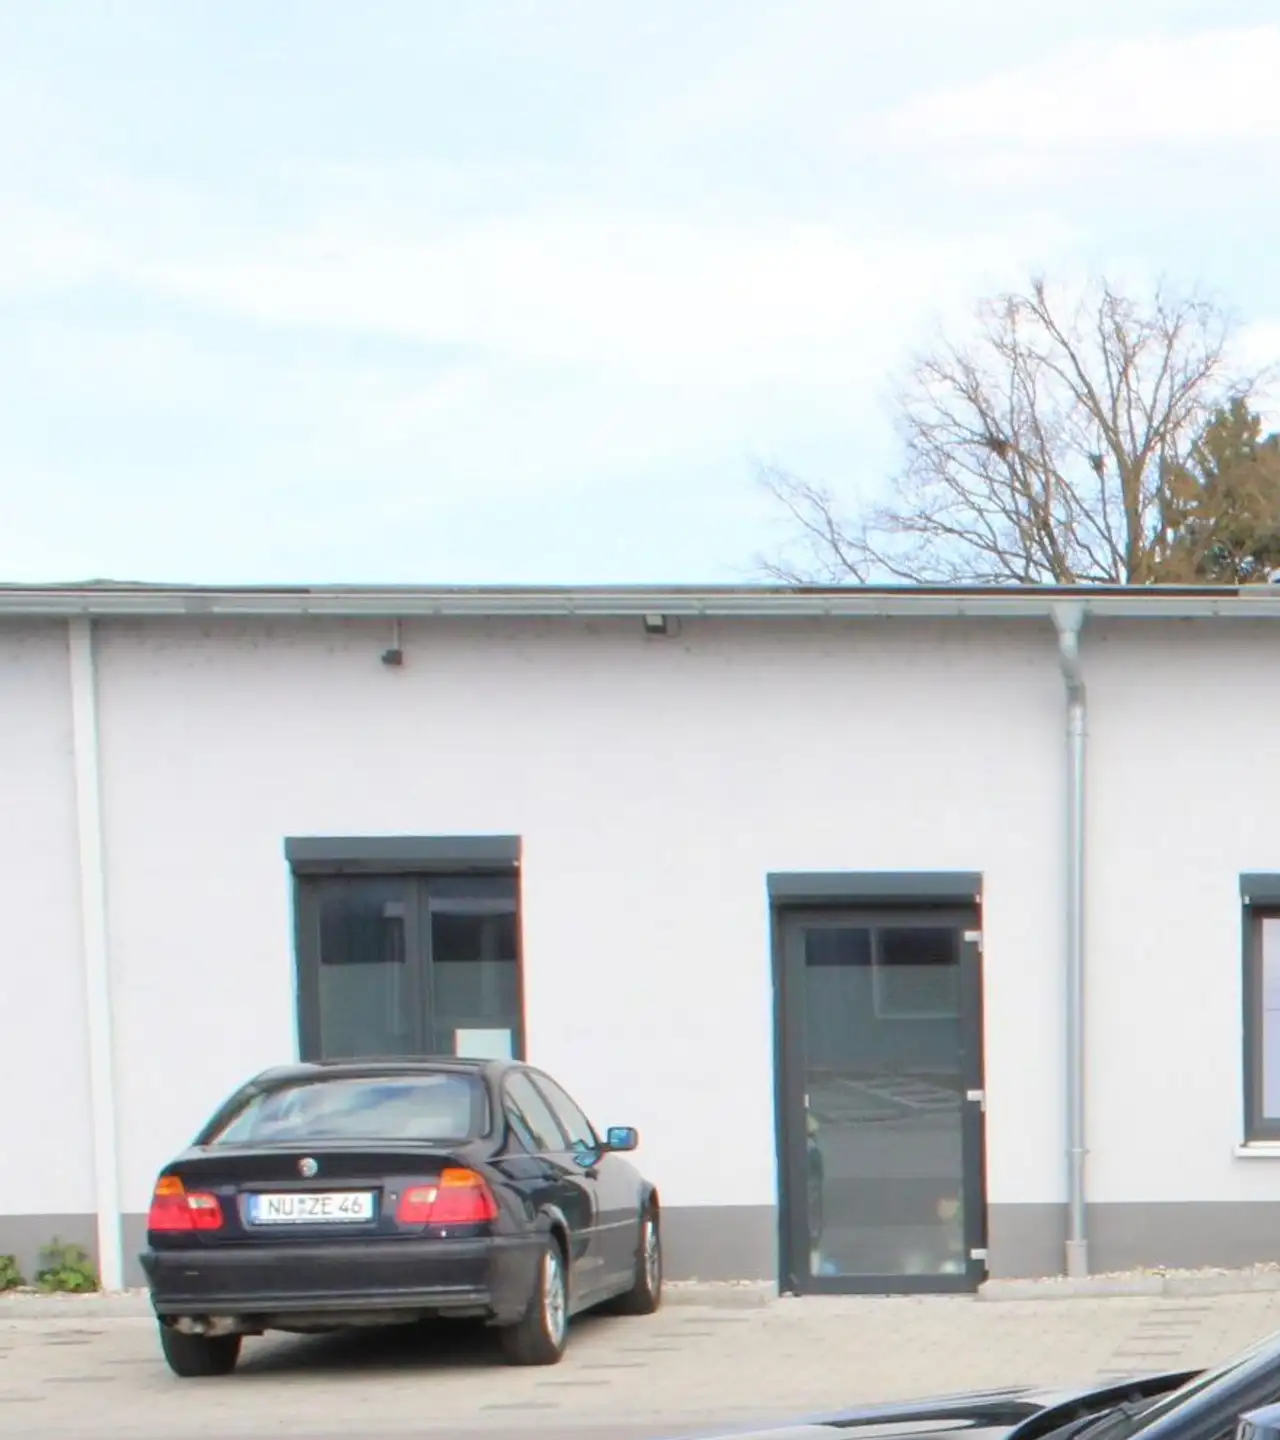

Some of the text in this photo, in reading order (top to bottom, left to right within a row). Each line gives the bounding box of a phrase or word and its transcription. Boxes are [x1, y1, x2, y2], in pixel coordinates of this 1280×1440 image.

[268, 1195, 363, 1215] NU ZE 46
